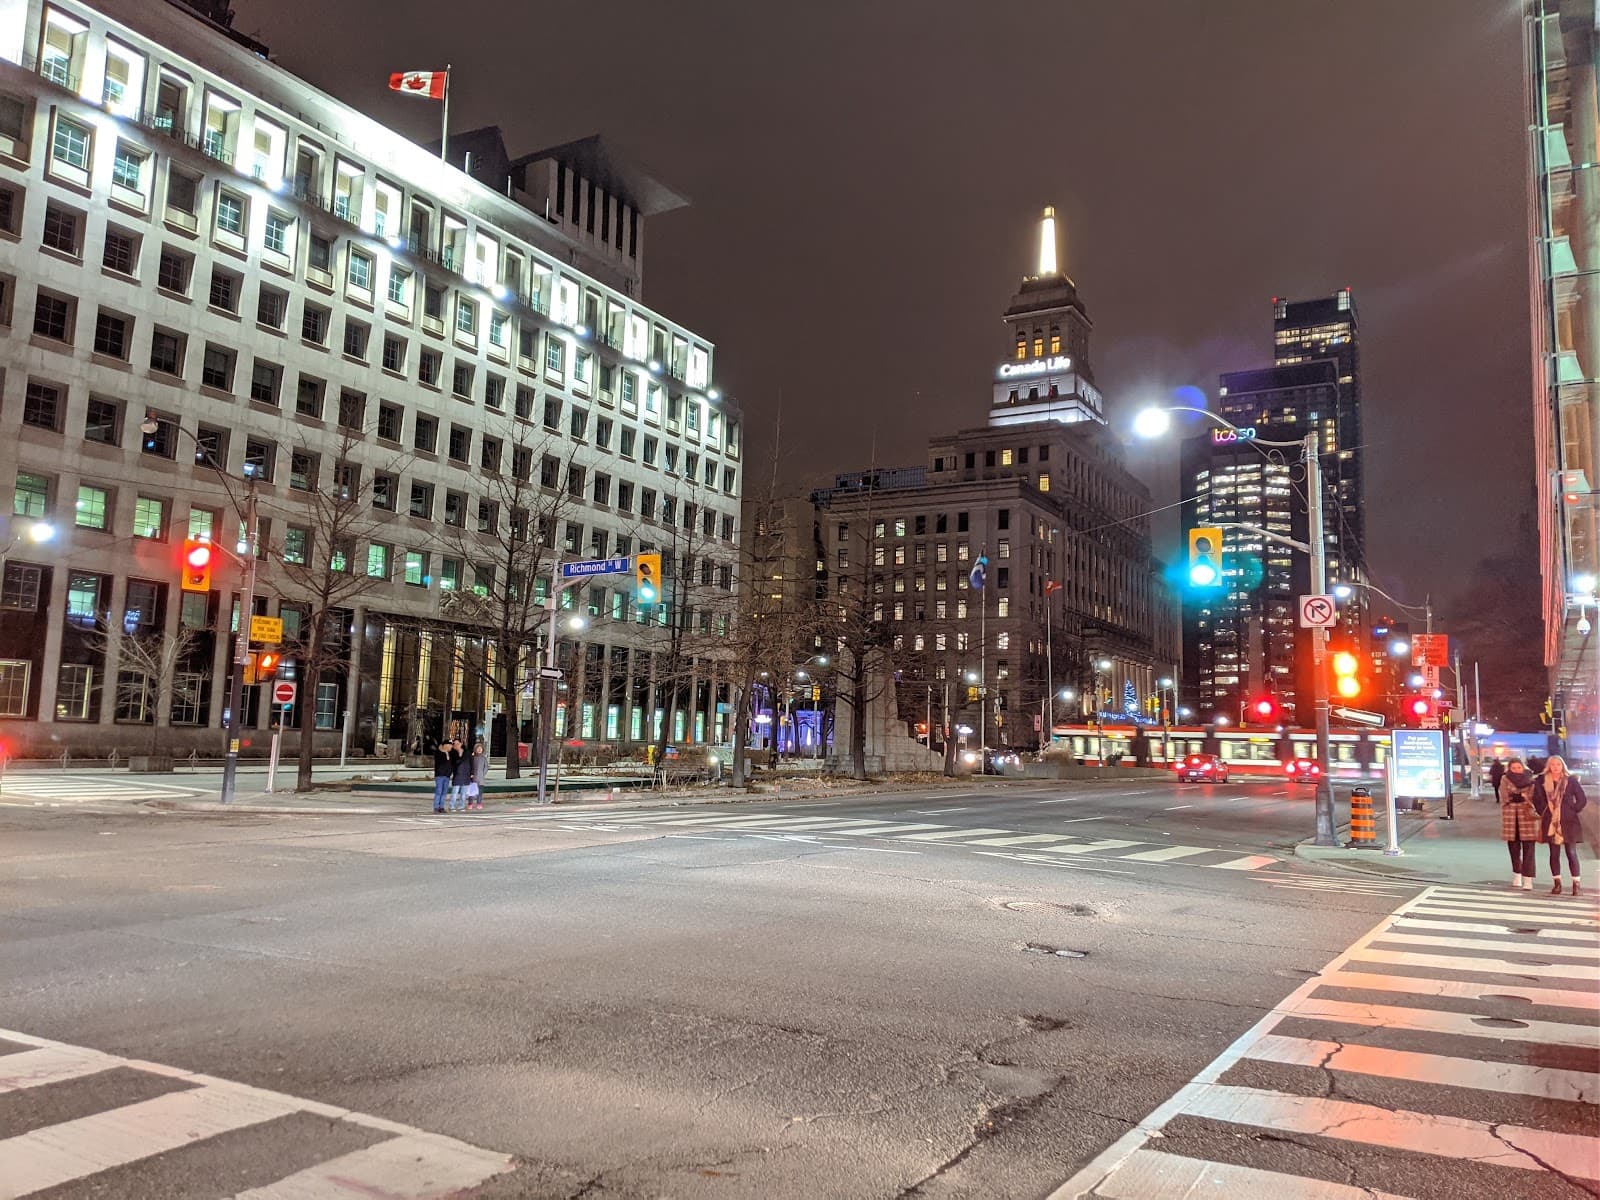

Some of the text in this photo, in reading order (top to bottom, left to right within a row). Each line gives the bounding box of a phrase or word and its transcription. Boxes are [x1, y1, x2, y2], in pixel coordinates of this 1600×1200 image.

[1000, 356, 1071, 376] Canada Life
[569, 562, 606, 574] Richmond
[614, 559, 622, 570] W
